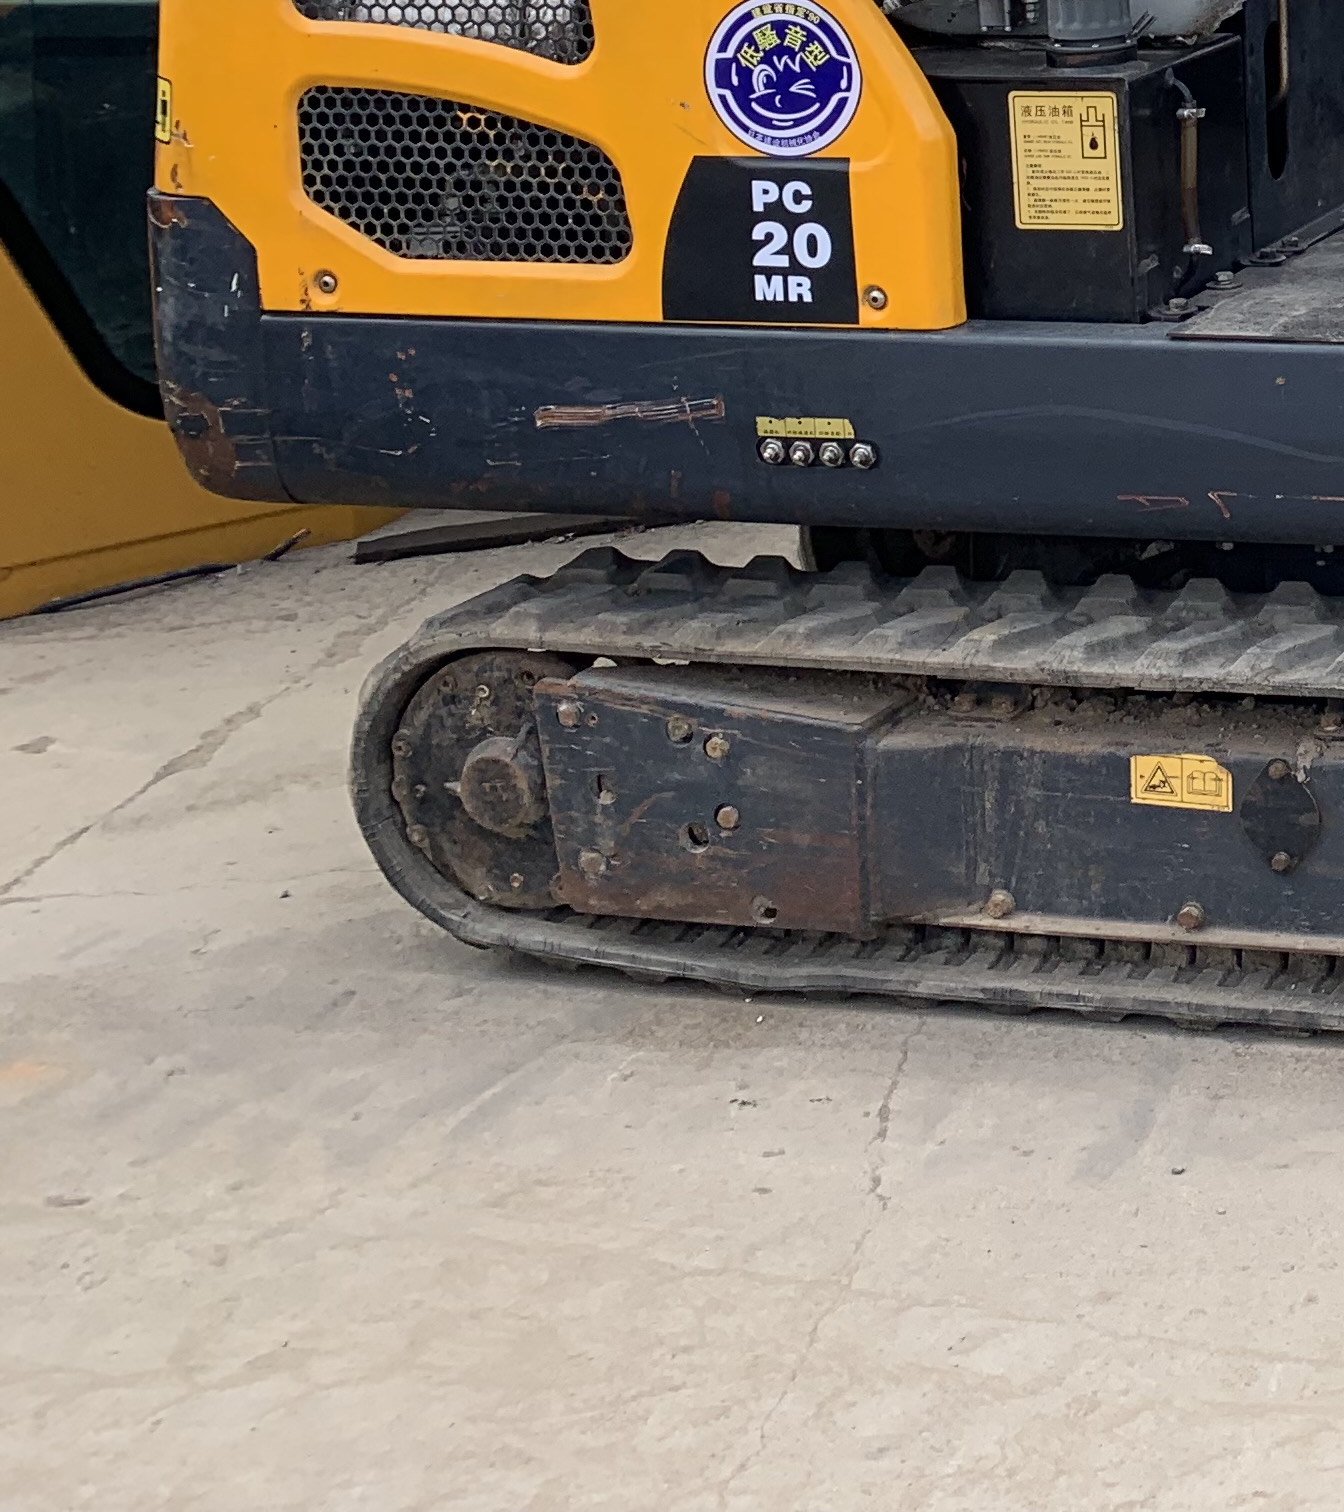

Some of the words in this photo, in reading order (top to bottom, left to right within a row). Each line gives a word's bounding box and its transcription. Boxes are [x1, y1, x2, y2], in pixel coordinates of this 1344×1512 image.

[1020, 105, 1074, 118] 液压油箱
[751, 179, 813, 214] PC
[751, 221, 832, 269] 20
[753, 274, 813, 303] MR
